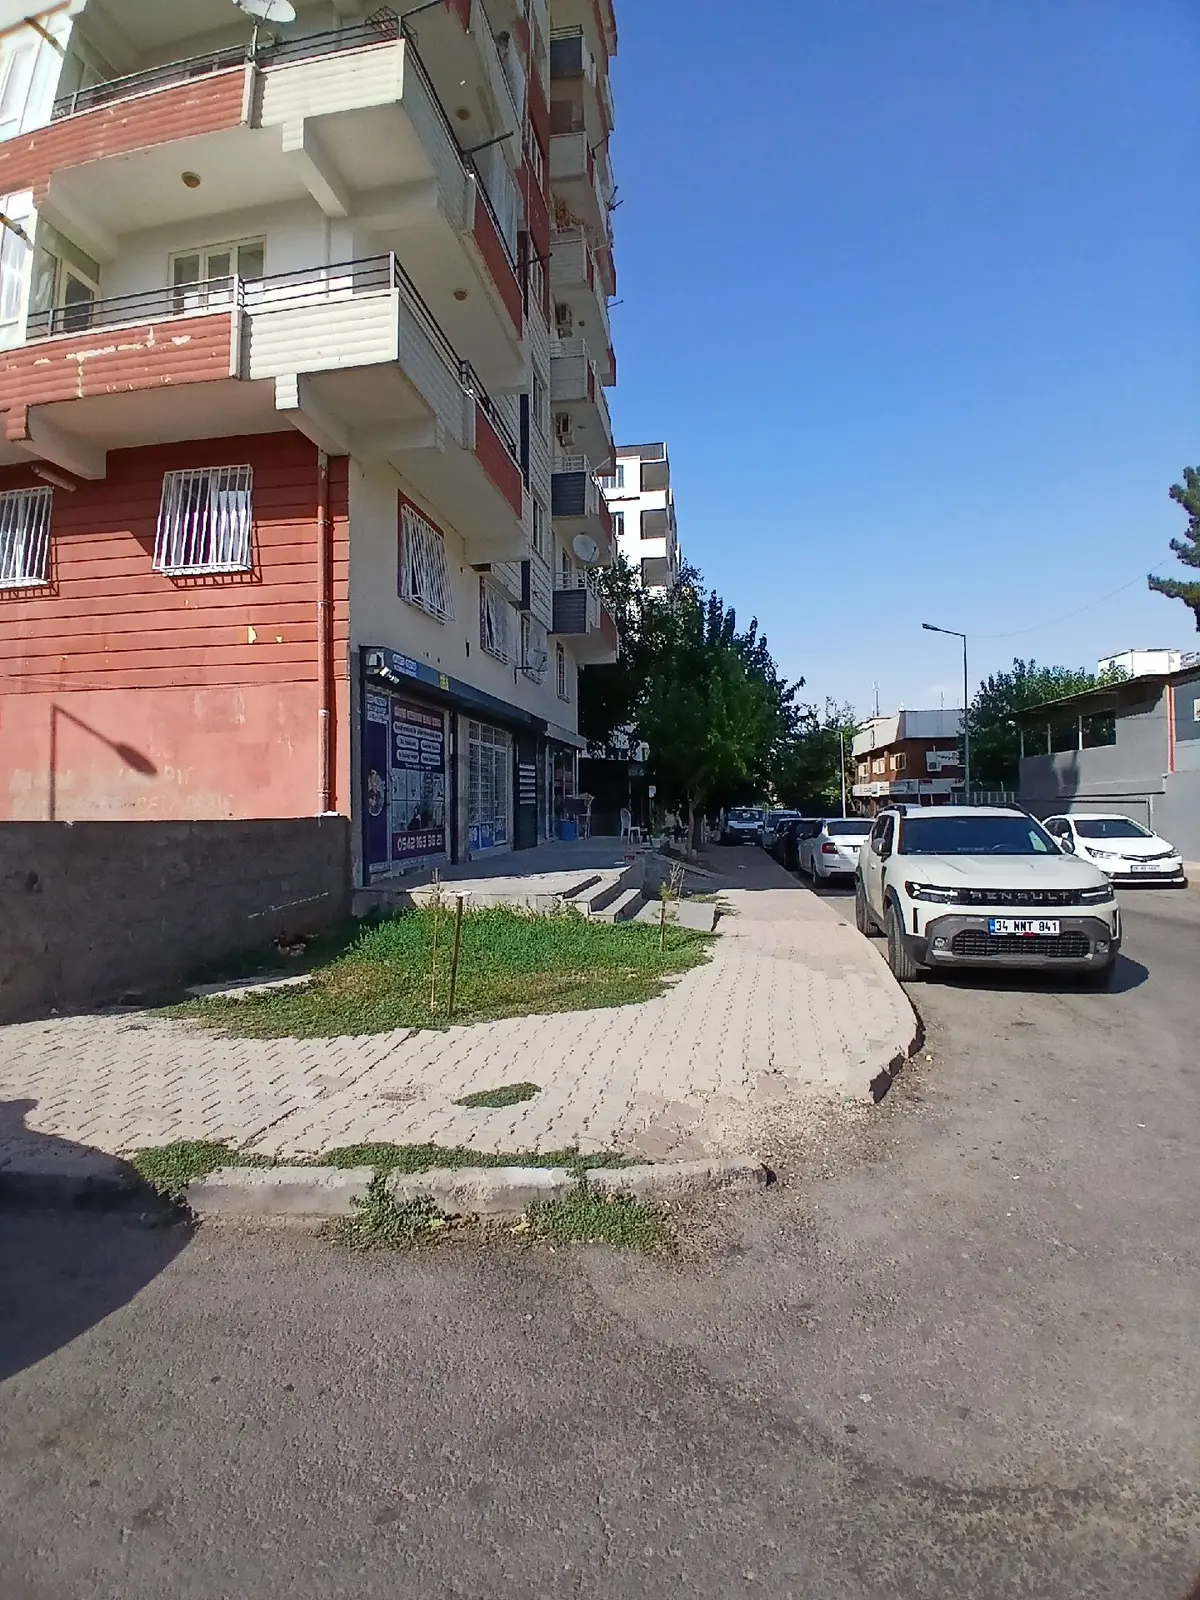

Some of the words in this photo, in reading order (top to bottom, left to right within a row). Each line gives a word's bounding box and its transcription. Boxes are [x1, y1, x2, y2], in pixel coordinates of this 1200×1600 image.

[971, 892, 1069, 900] RENAULT
[996, 920, 1008, 931] 34
[1013, 921, 1033, 931] NNT
[1038, 920, 1057, 931] 841
